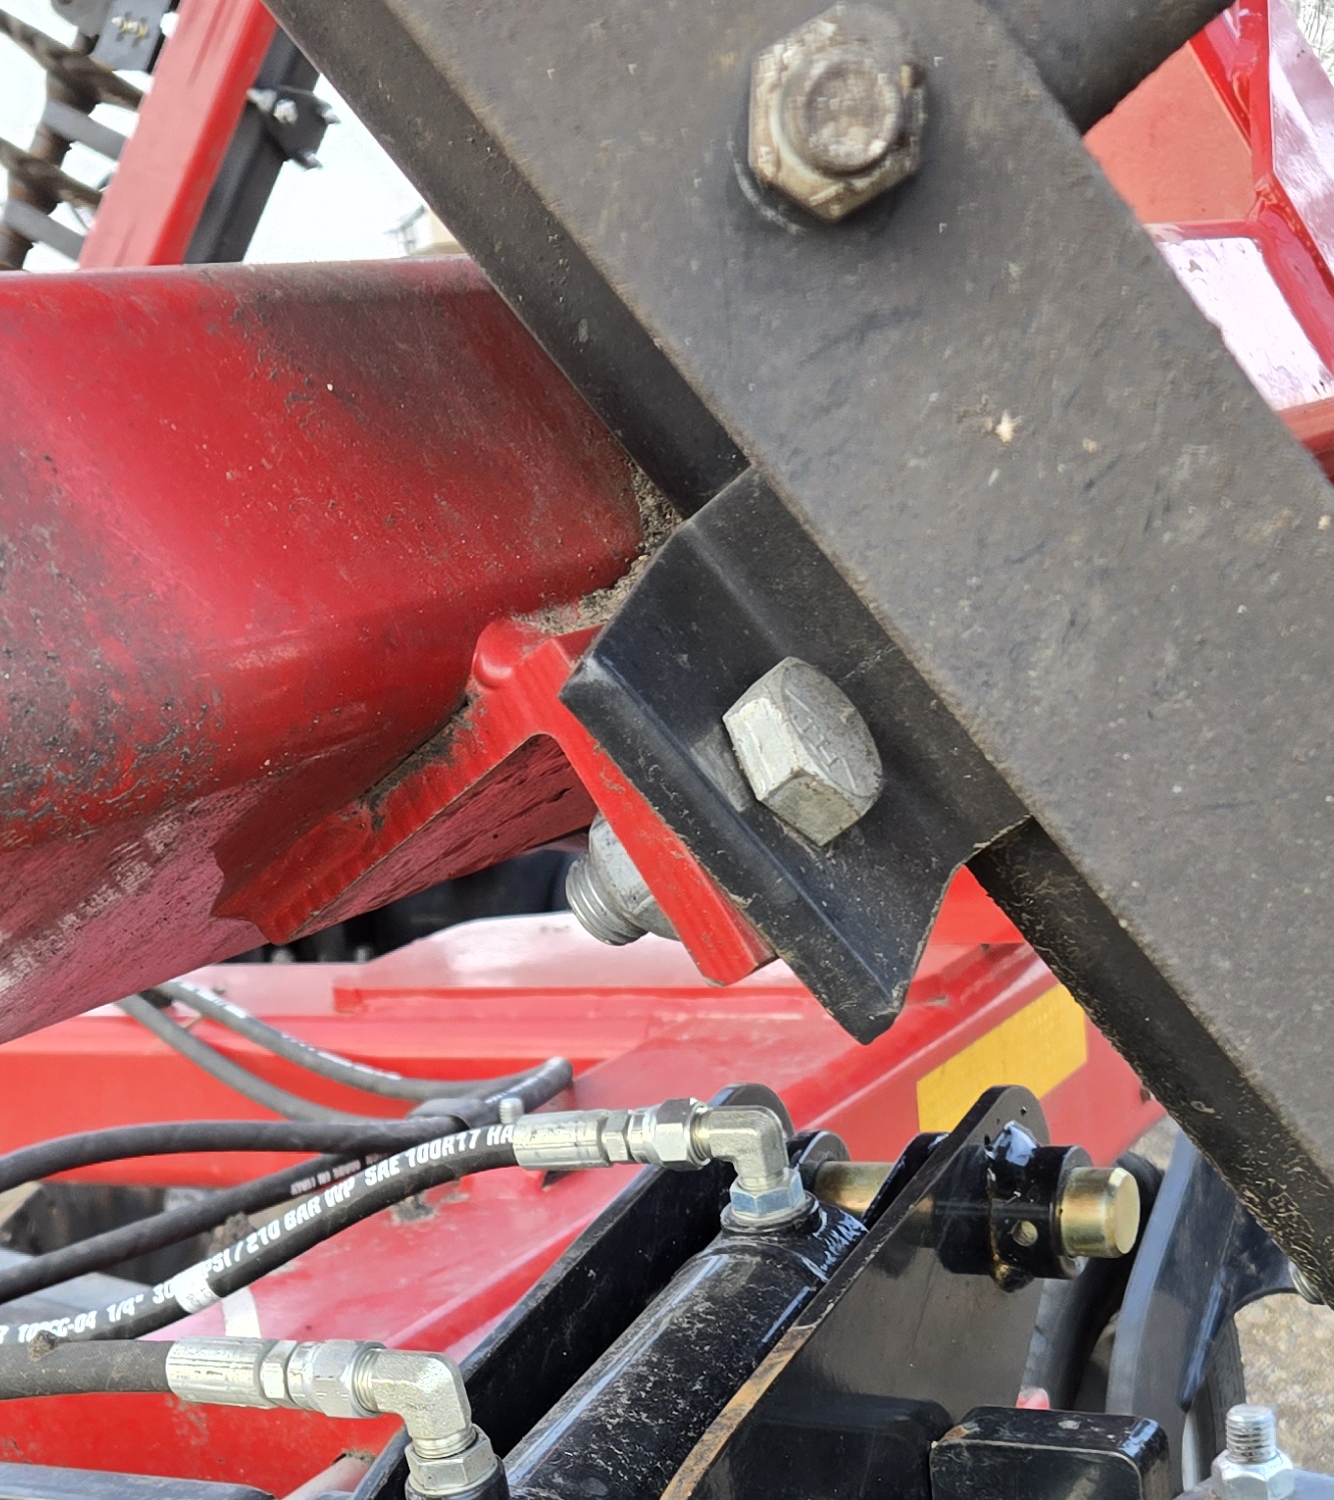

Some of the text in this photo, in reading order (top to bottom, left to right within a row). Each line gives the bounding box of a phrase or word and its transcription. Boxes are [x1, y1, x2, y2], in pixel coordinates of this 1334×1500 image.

[106, 1293, 144, 1322] 1/4"
[246, 1223, 281, 1254] 210
[283, 1196, 322, 1232] BAR
[324, 1177, 355, 1208] WP
[364, 1153, 401, 1186] SAE
[404, 1128, 482, 1169] 100R17
